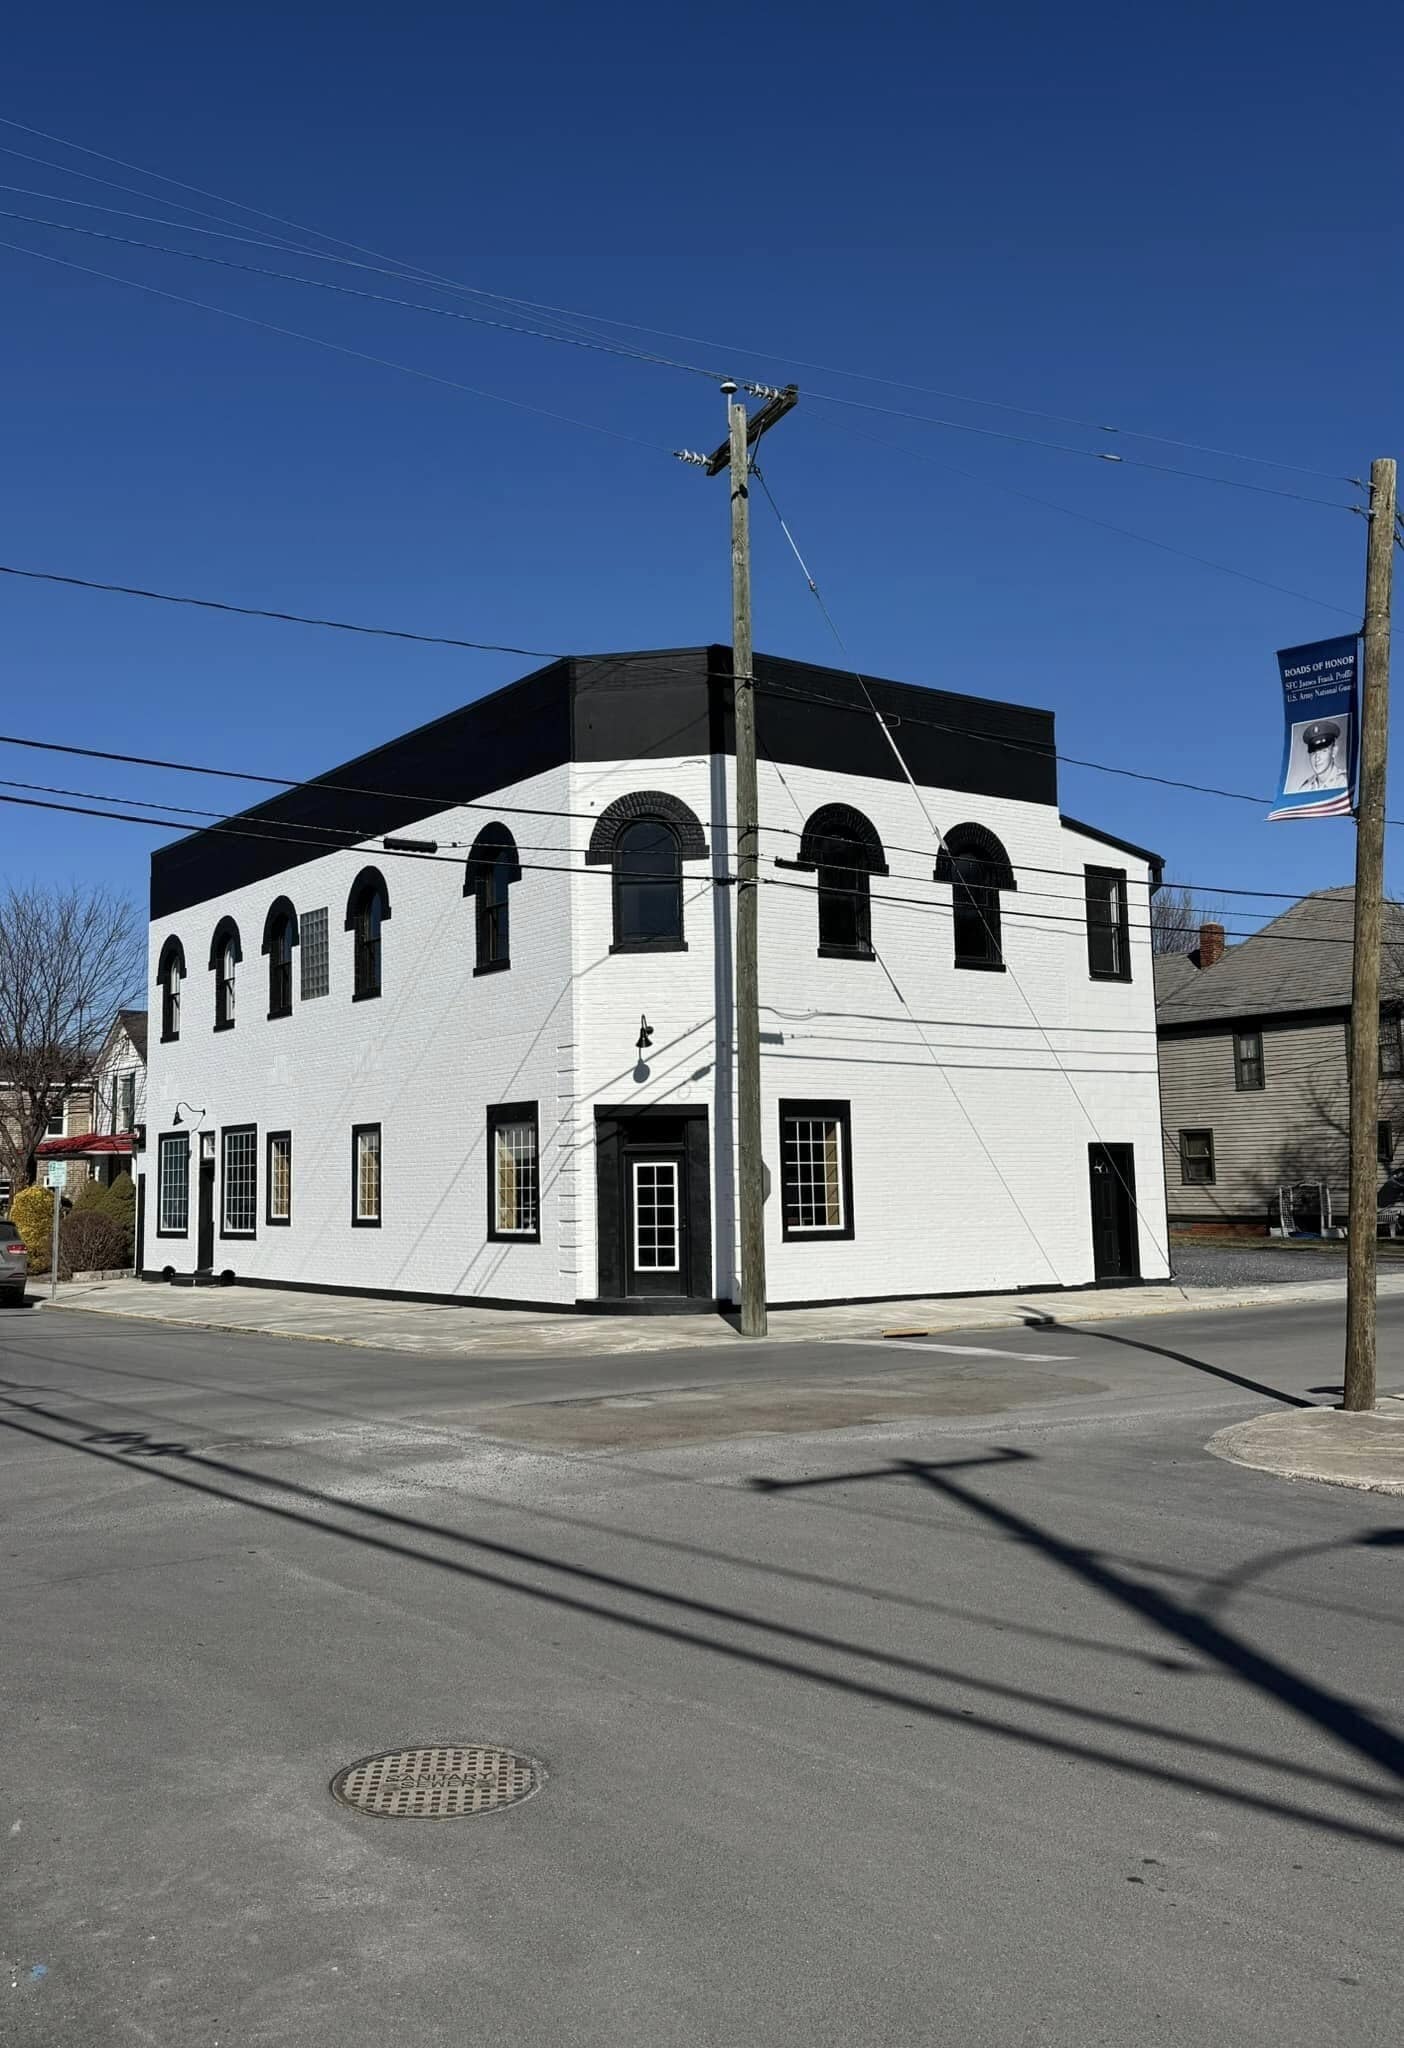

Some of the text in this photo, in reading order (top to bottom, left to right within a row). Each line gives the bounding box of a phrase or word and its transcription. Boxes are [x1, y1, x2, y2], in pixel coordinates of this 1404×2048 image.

[1284, 655, 1354, 677] ROADS OF HONOR
[1299, 679, 1317, 688] James
[1318, 674, 1334, 684] Frank
[1299, 692, 1313, 700] Army
[1314, 685, 1338, 696] National
[385, 1772, 493, 1782] SANITARY
[400, 1779, 475, 1789] SEWER
